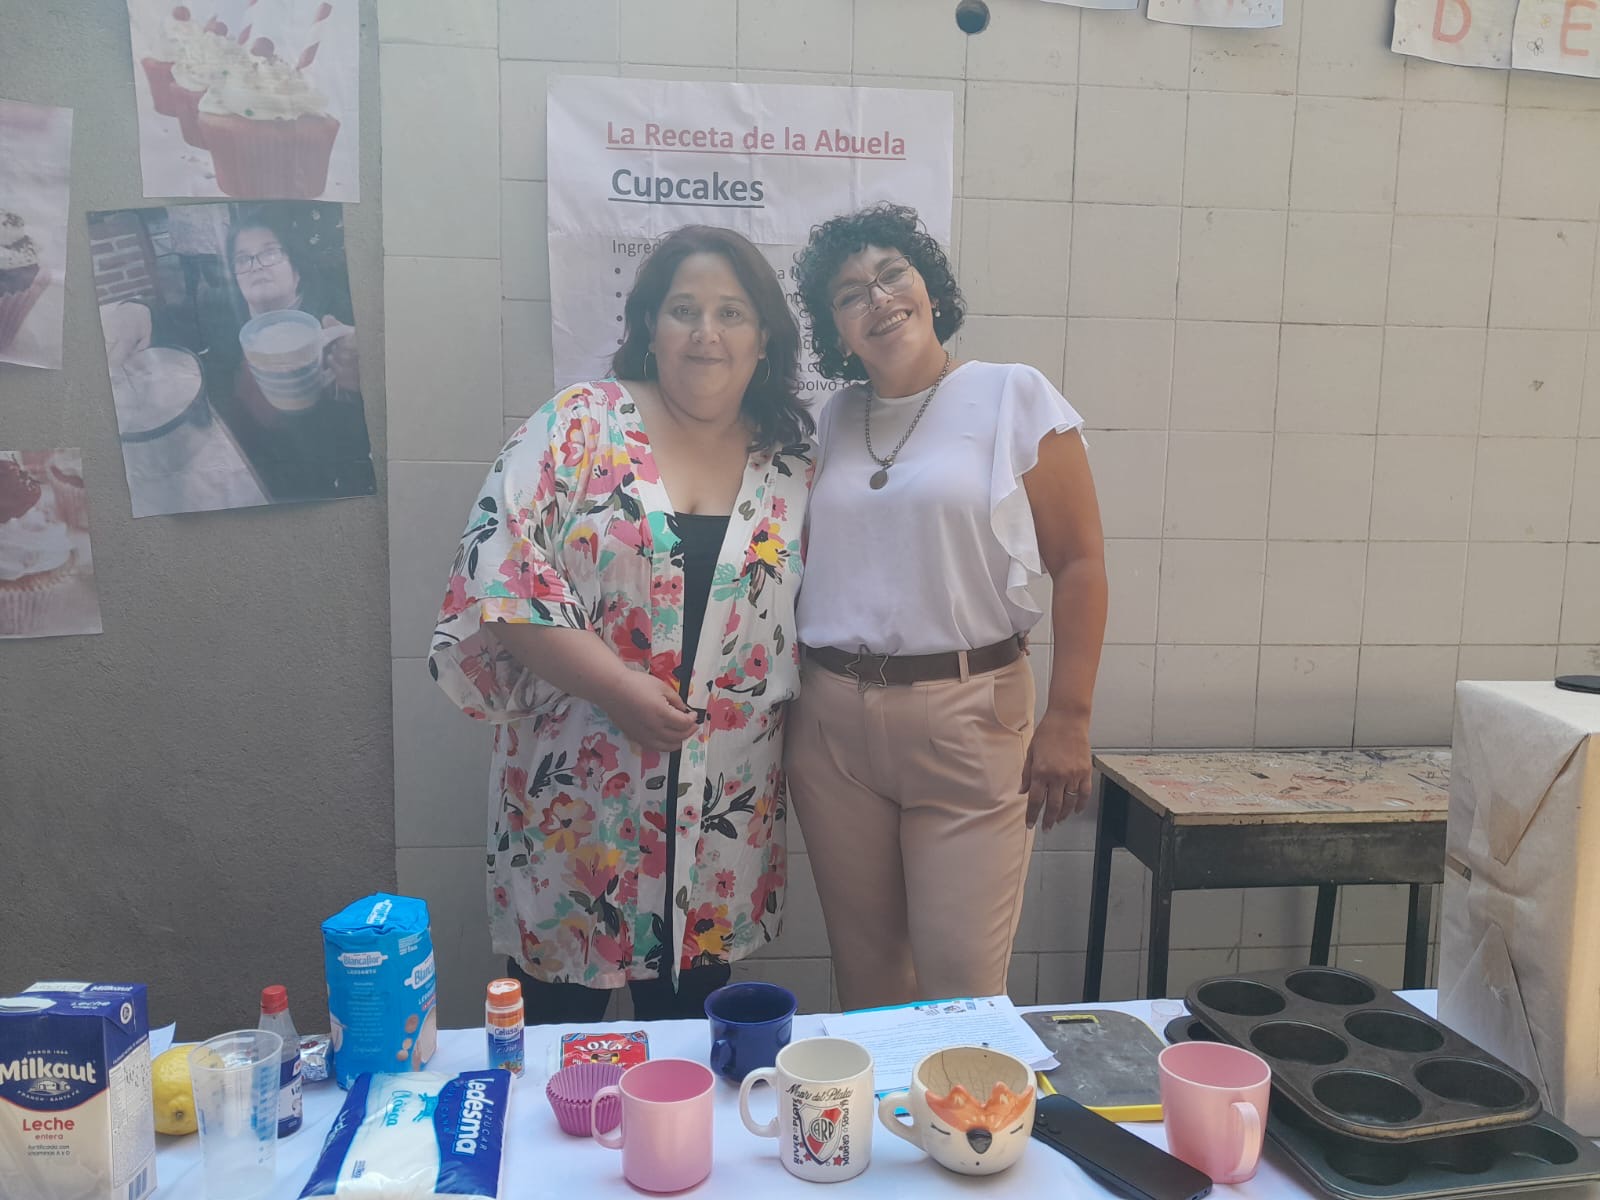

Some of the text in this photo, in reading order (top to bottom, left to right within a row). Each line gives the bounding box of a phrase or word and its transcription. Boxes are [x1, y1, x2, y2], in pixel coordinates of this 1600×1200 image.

[607, 121, 905, 155] La Receta de la Abuela
[611, 168, 764, 204] Cupcakes
[343, 954, 380, 966] Blancaflor
[0, 1057, 97, 1085] Milkaut
[22, 1117, 75, 1131] Leche
